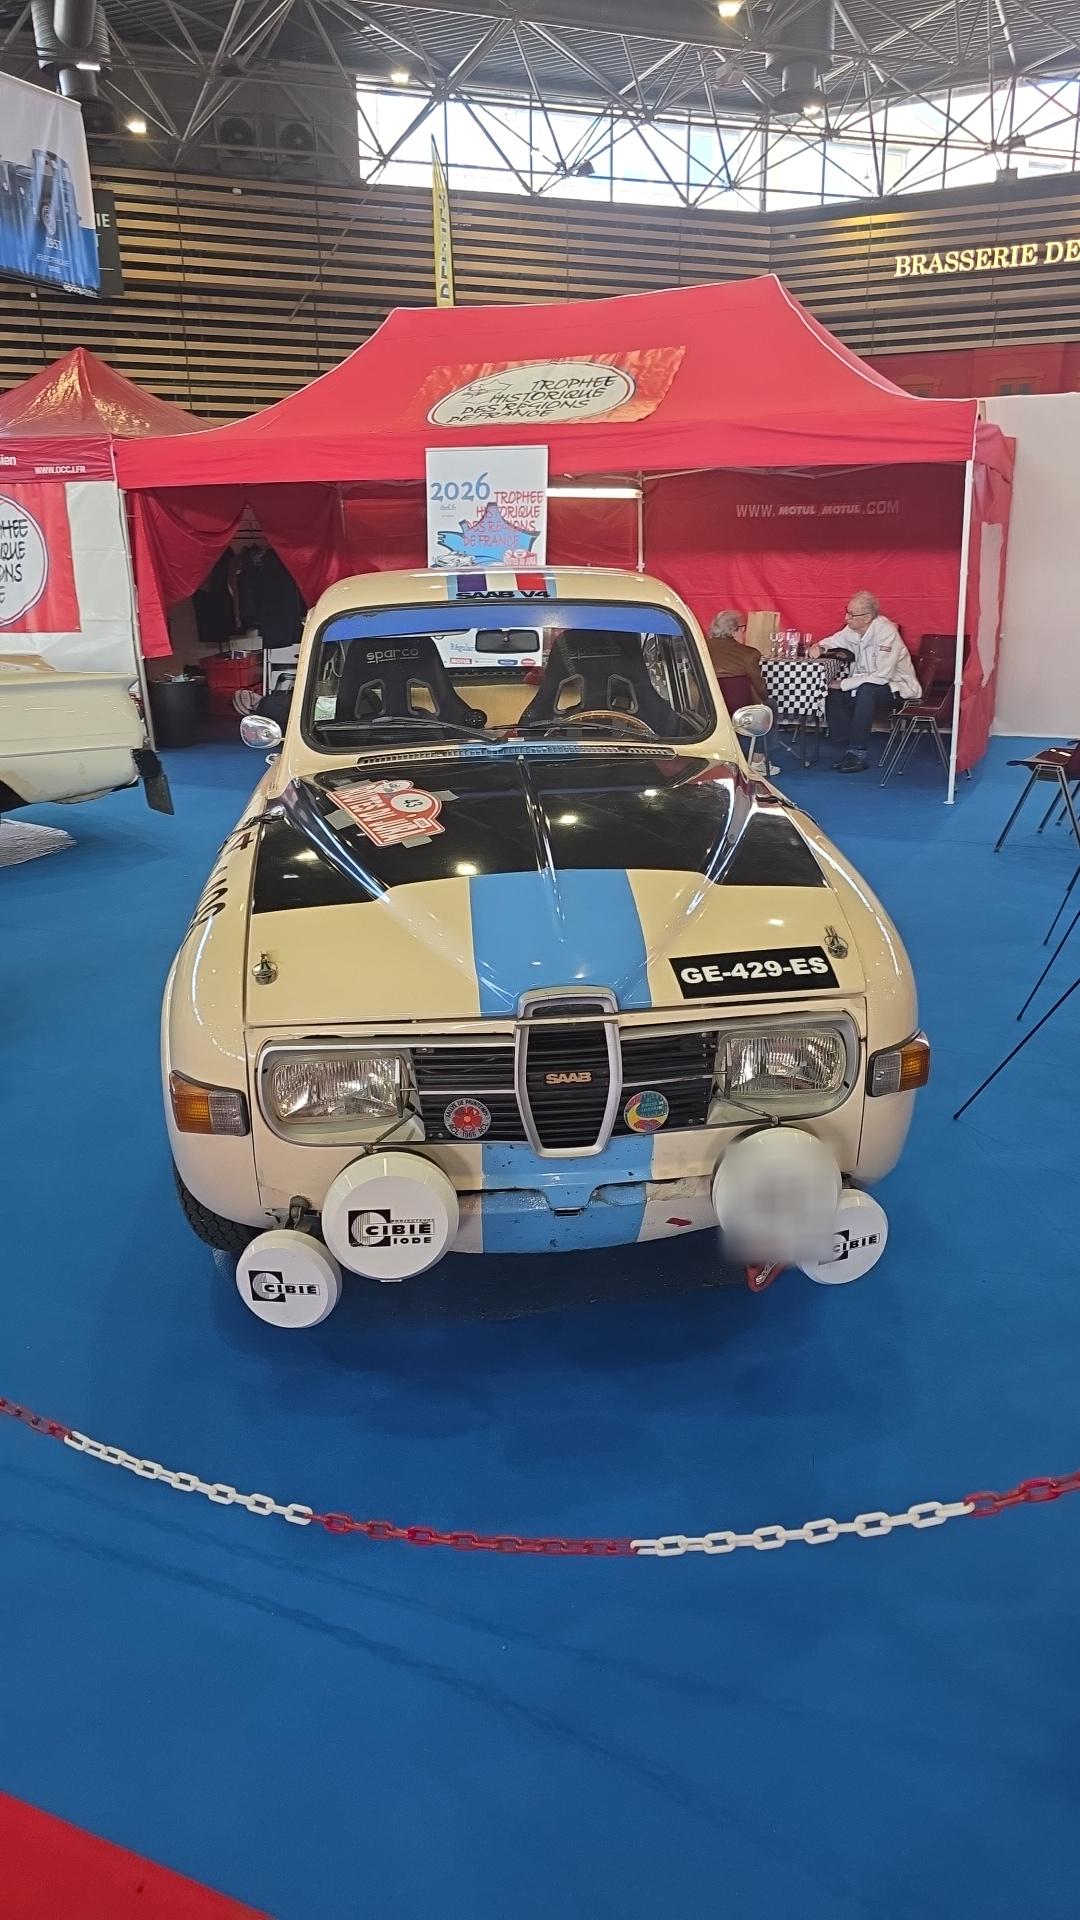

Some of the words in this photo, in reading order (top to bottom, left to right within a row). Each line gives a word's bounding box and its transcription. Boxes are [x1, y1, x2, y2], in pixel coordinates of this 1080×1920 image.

[894, 243, 1038, 278] BRASSERIE
[531, 376, 618, 391] TROPHEE
[489, 388, 607, 404] HISTORIQUE
[461, 404, 500, 415] DES
[502, 400, 591, 411] REGIONS
[475, 409, 555, 420] FRANCE
[430, 472, 491, 502] 2026
[493, 490, 545, 505] TROPHEE
[456, 590, 515, 600] SAAB
[519, 590, 550, 598] V4
[366, 648, 419, 663] sparco
[680, 957, 829, 984] GE-429-ES
[545, 1071, 592, 1084] SAAB
[393, 1236, 432, 1245] IODE
